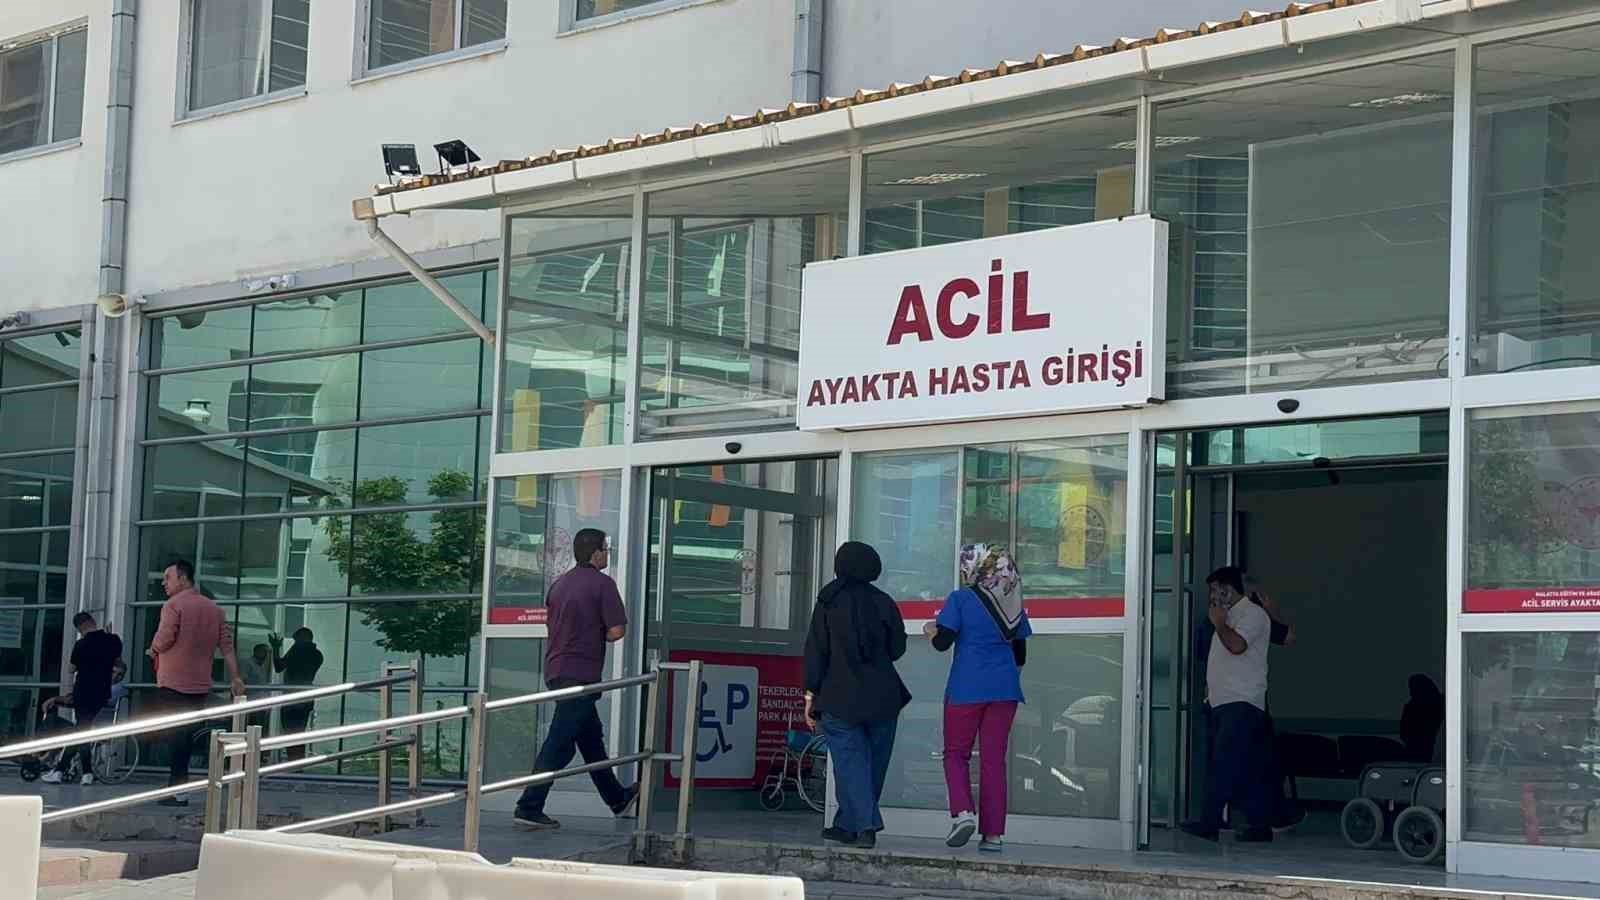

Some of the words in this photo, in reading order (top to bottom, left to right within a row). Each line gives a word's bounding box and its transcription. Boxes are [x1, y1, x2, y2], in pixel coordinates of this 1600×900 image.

[886, 259, 1051, 345] ACİL
[806, 371, 918, 407] AYAKTA
[929, 359, 1031, 396] HASTA
[1042, 340, 1143, 387] GİRİŞİ
[1521, 597, 1540, 608] ACİL
[1541, 597, 1569, 608] SERVİS
[758, 711, 780, 721] PARK
